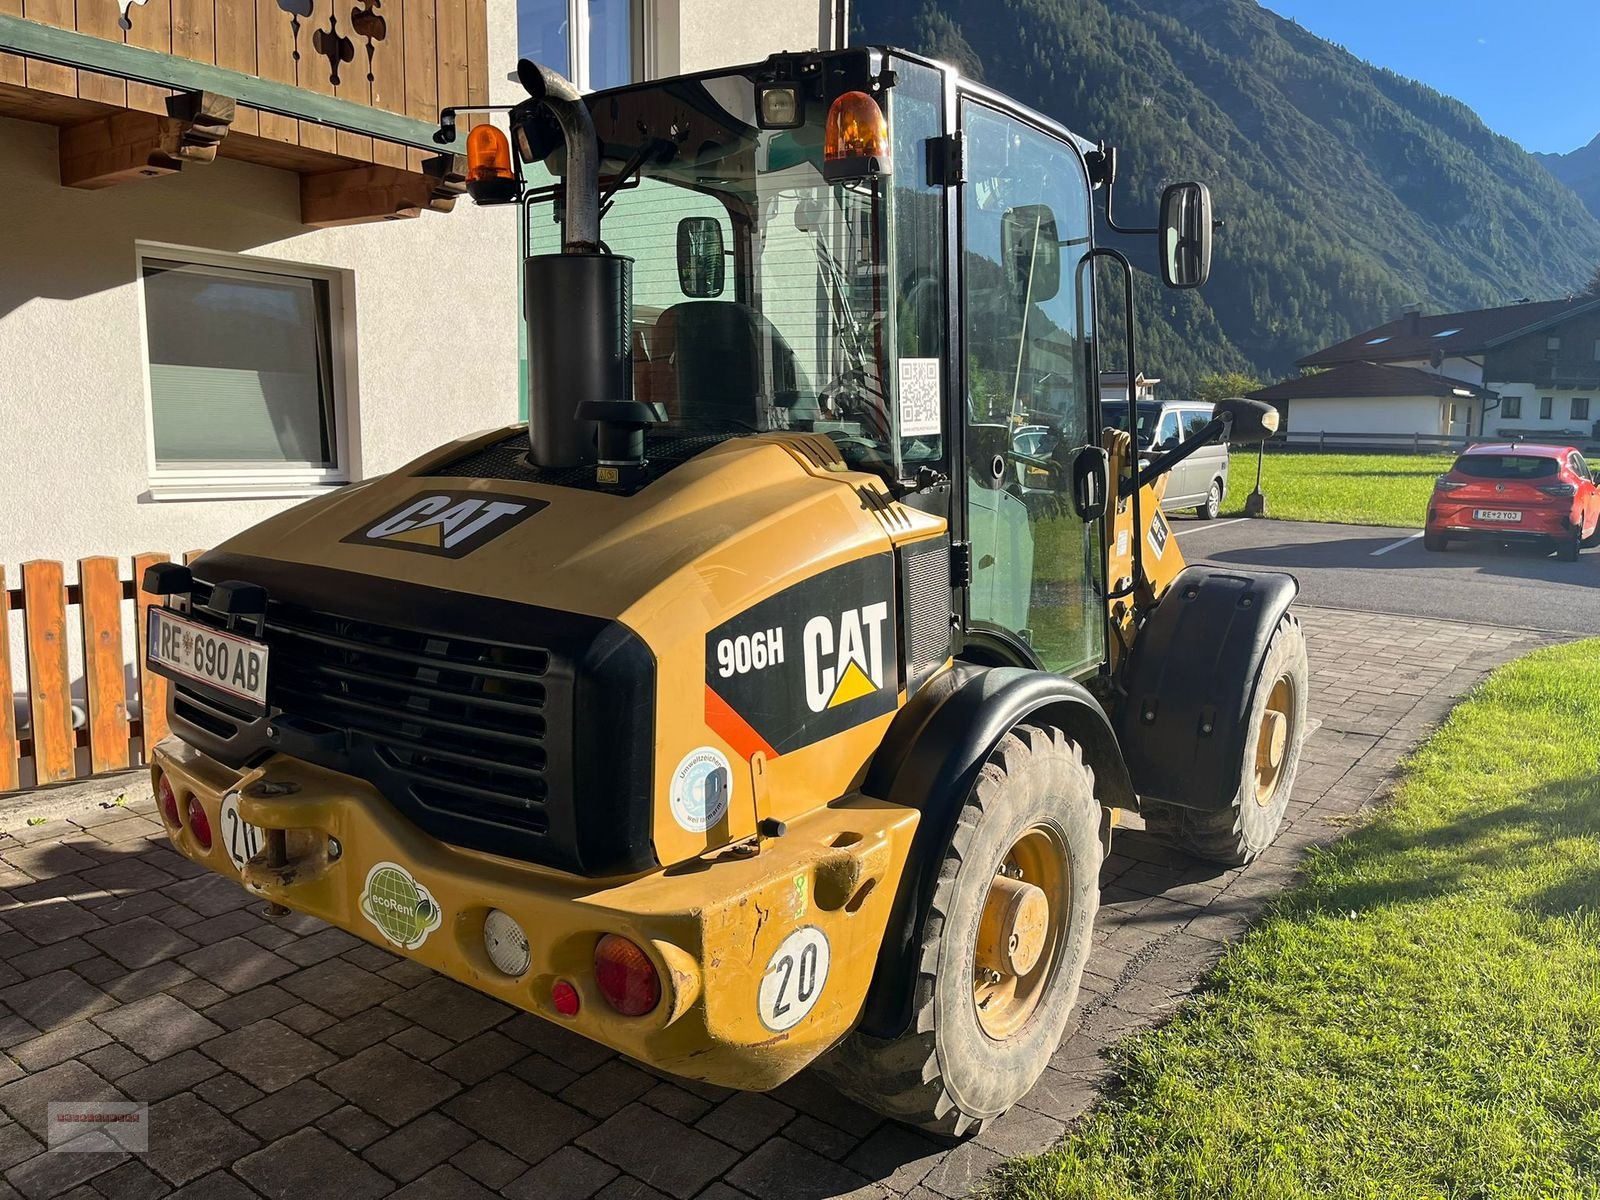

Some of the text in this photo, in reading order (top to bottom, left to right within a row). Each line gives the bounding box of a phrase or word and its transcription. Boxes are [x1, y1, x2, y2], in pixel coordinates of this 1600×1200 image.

[366, 495, 527, 549] CAT
[161, 621, 260, 692] RE 690 AB
[717, 601, 888, 713] 906H CAT
[372, 894, 414, 917] ecoRent
[772, 942, 818, 1018] 20
